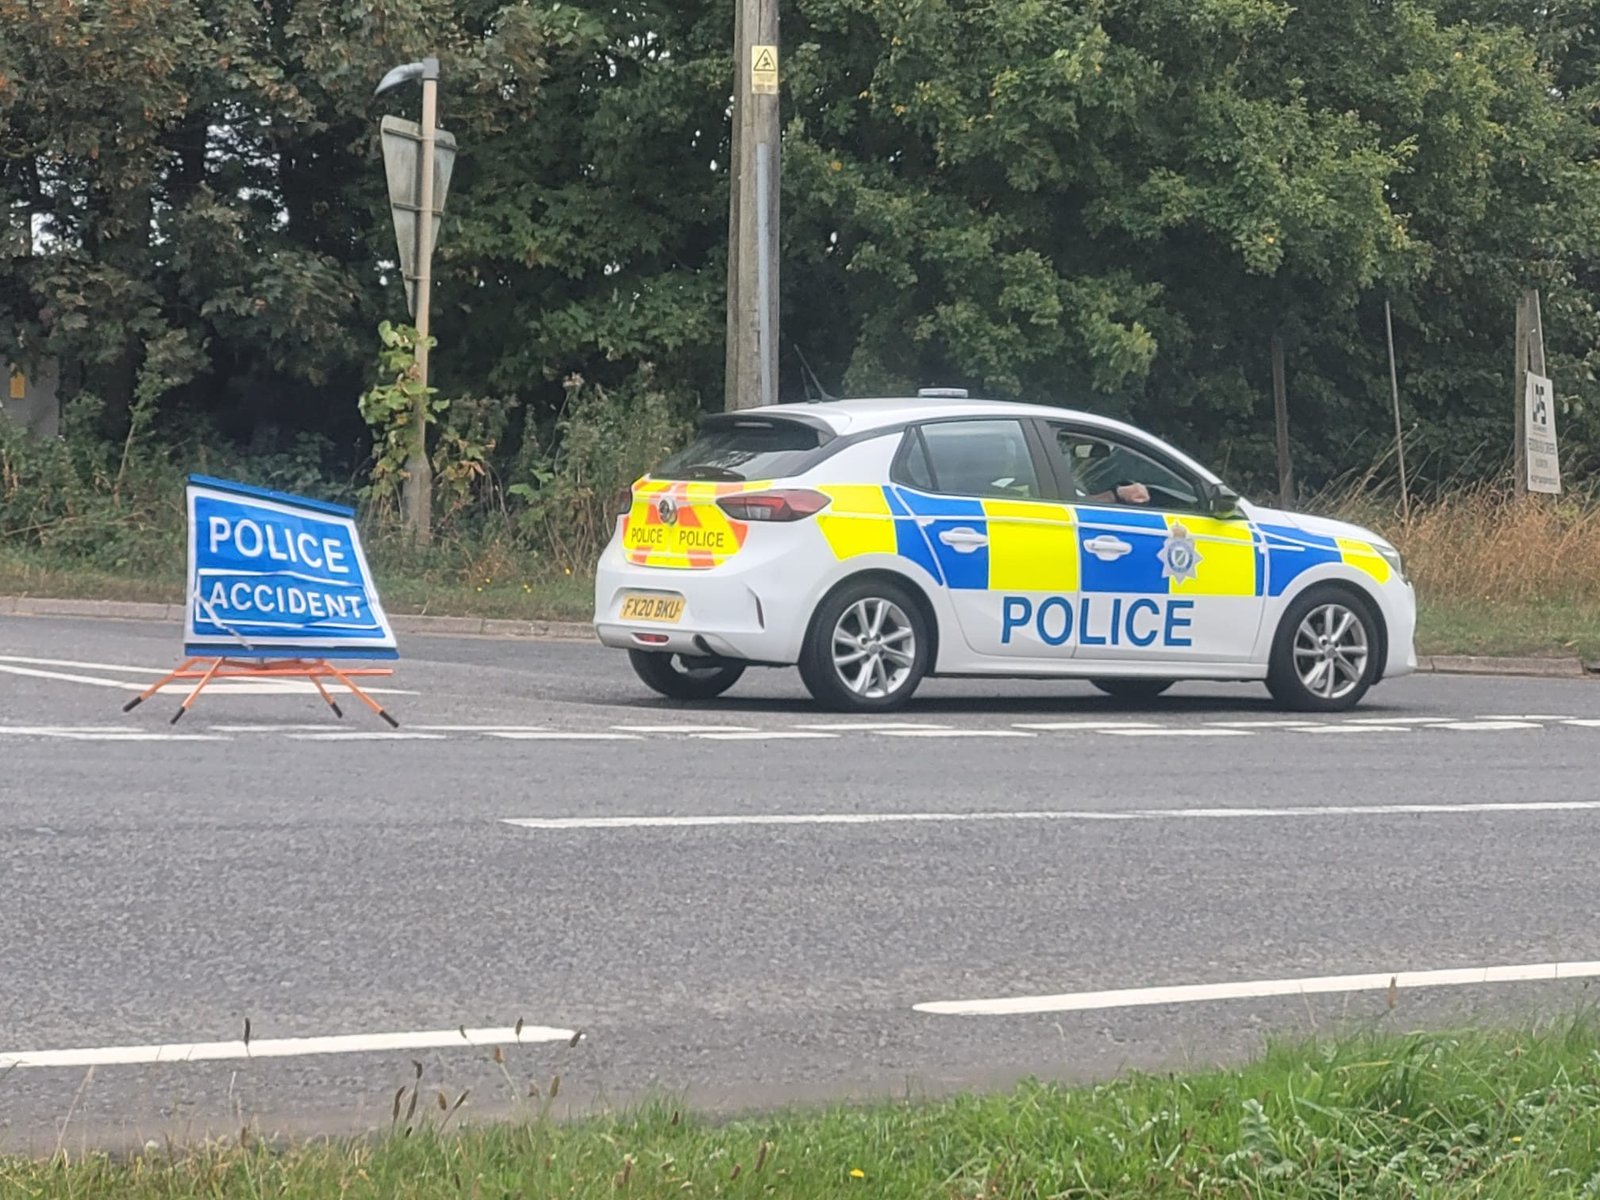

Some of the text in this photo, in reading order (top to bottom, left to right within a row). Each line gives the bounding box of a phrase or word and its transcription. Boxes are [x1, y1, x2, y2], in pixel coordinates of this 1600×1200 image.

[208, 516, 350, 574] POLICE
[631, 527, 725, 548] POLICE POLICE
[209, 581, 362, 619] ACCIDENT
[624, 598, 679, 619] FX20 BKU
[1001, 596, 1194, 647] POLICE
